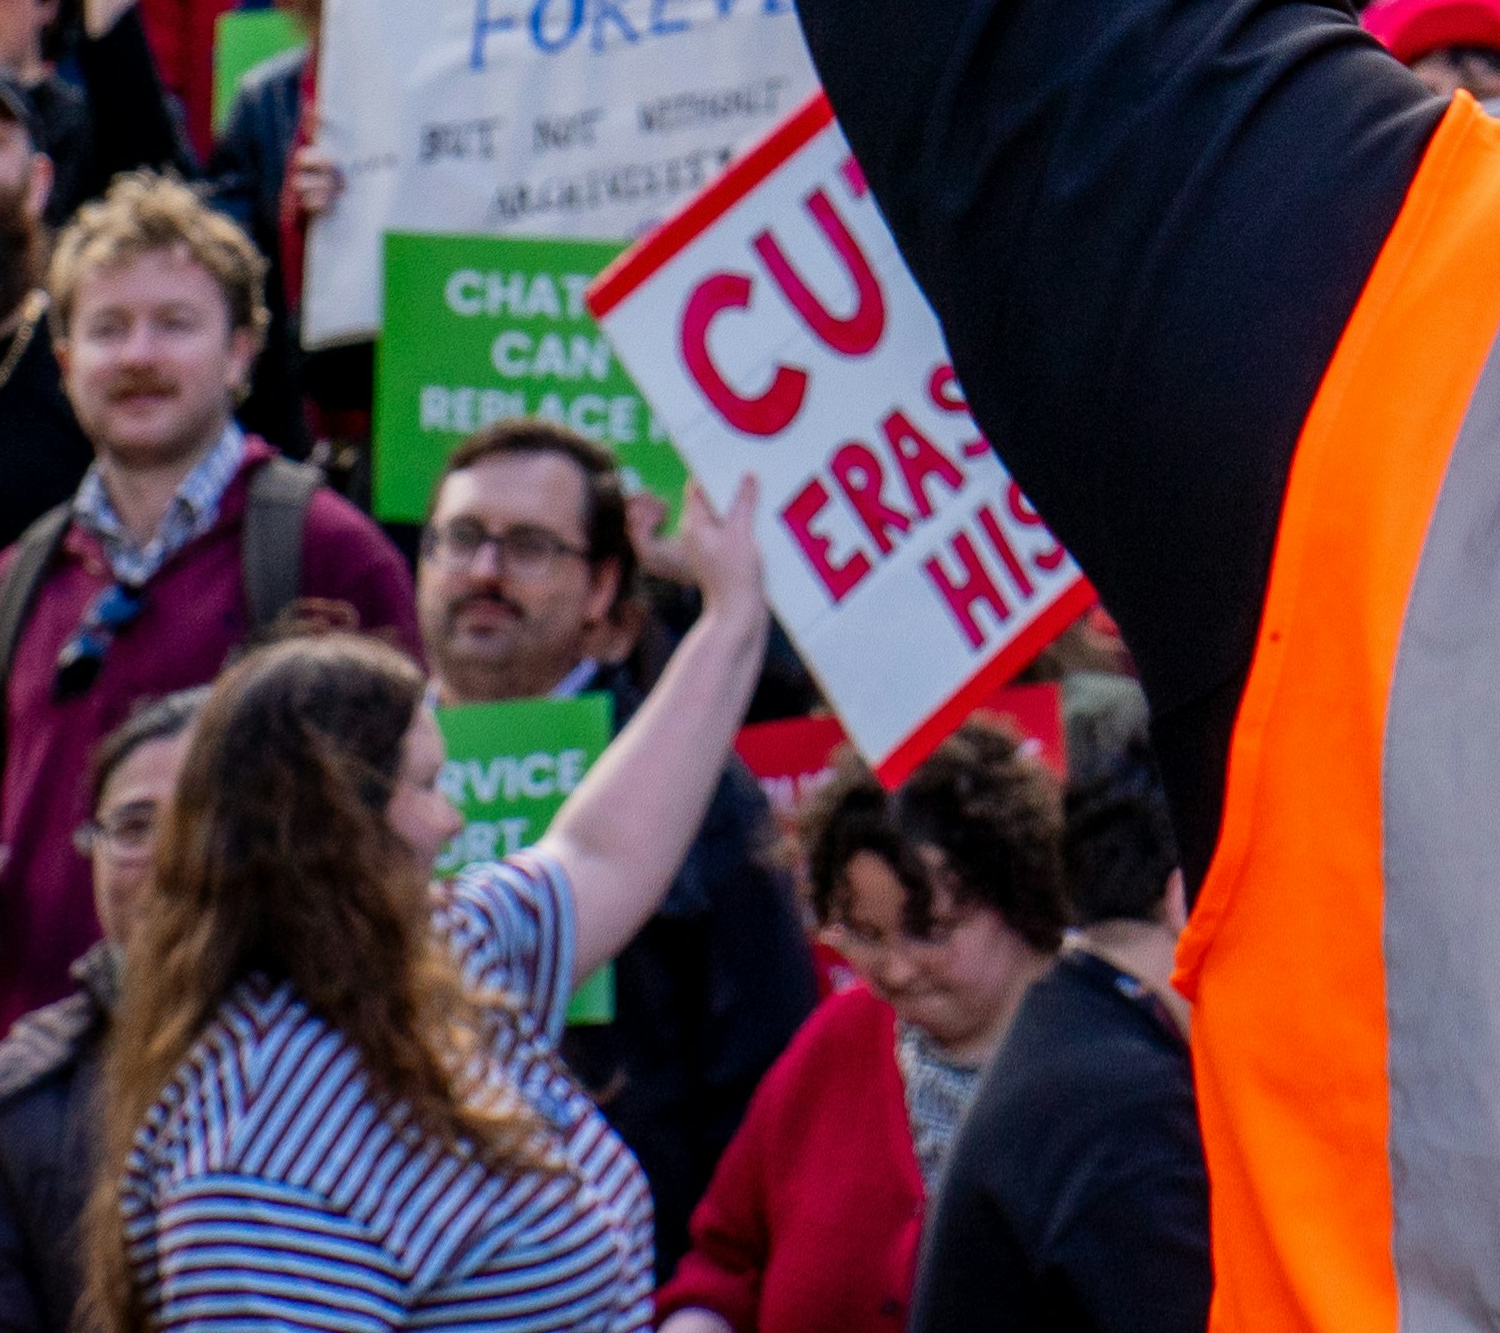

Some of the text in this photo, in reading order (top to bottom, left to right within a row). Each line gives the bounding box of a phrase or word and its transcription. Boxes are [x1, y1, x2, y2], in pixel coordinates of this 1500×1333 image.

[445, 269, 587, 319] CHAT
[419, 383, 638, 440] REPLACE
[778, 363, 993, 606] ERAS
[438, 747, 588, 805] RVICE
